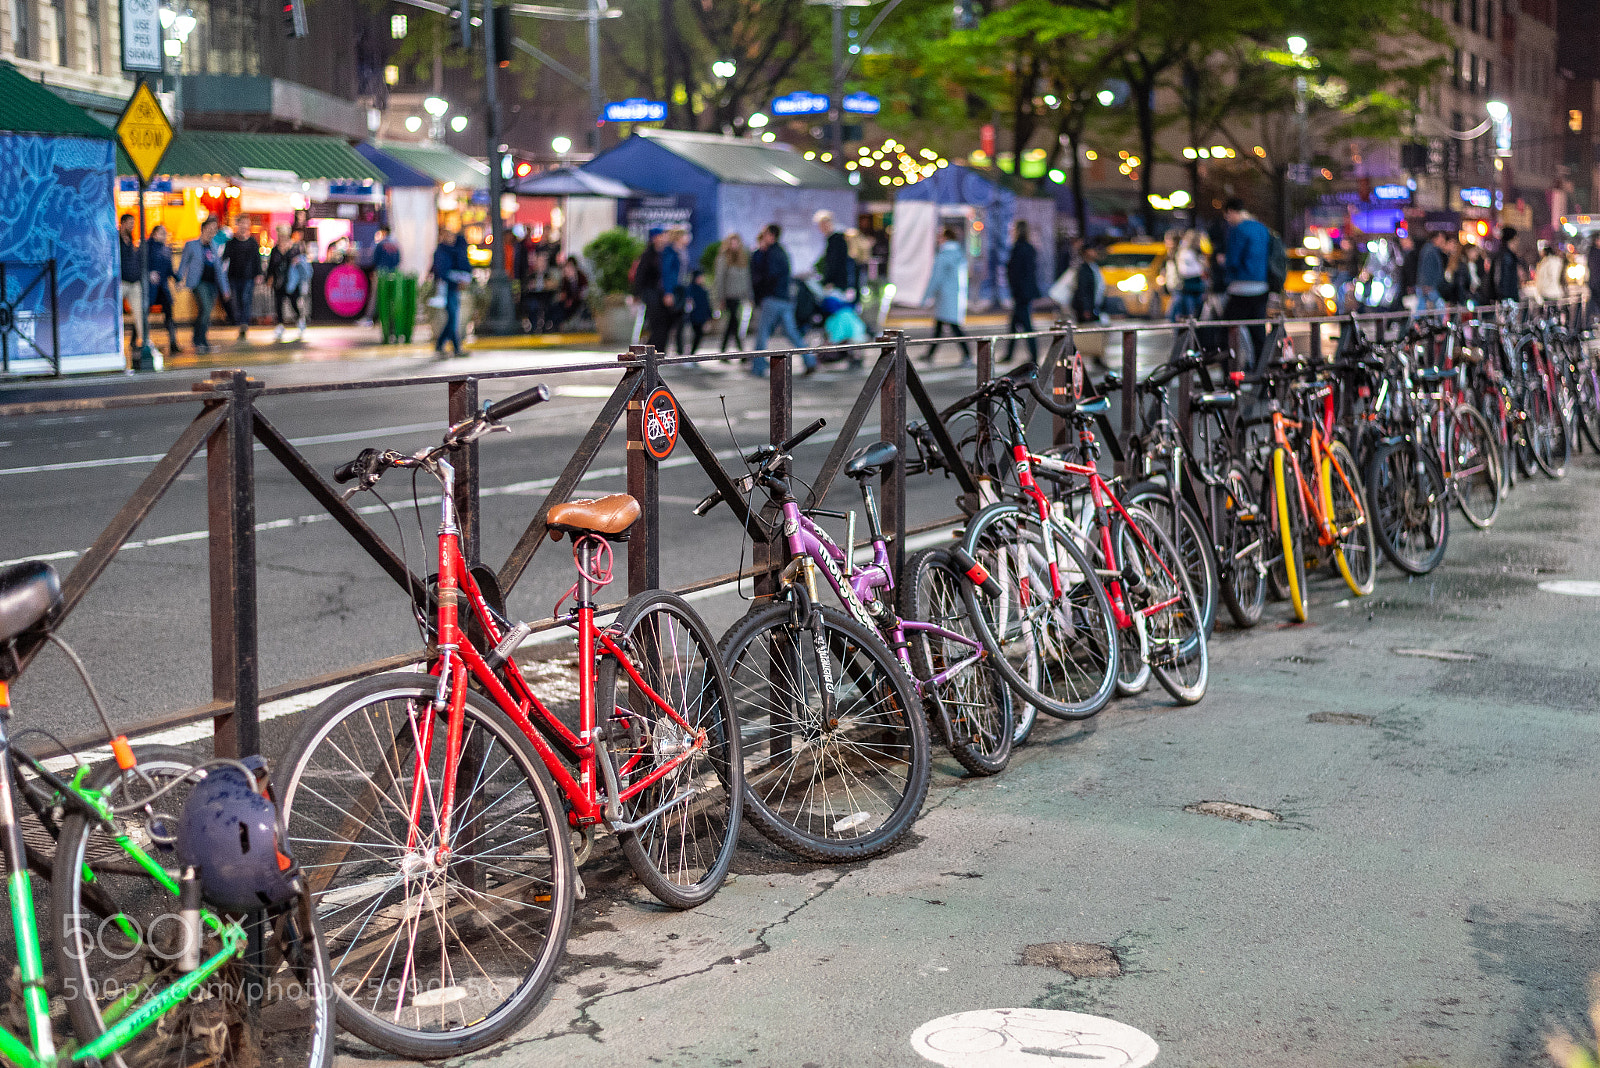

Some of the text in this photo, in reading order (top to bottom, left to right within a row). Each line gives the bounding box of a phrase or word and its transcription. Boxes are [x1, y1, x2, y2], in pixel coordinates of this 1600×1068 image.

[132, 19, 150, 32] USE
[133, 33, 150, 47] PED
[127, 48, 158, 62] SIGNAL
[128, 127, 165, 150] SLOW
